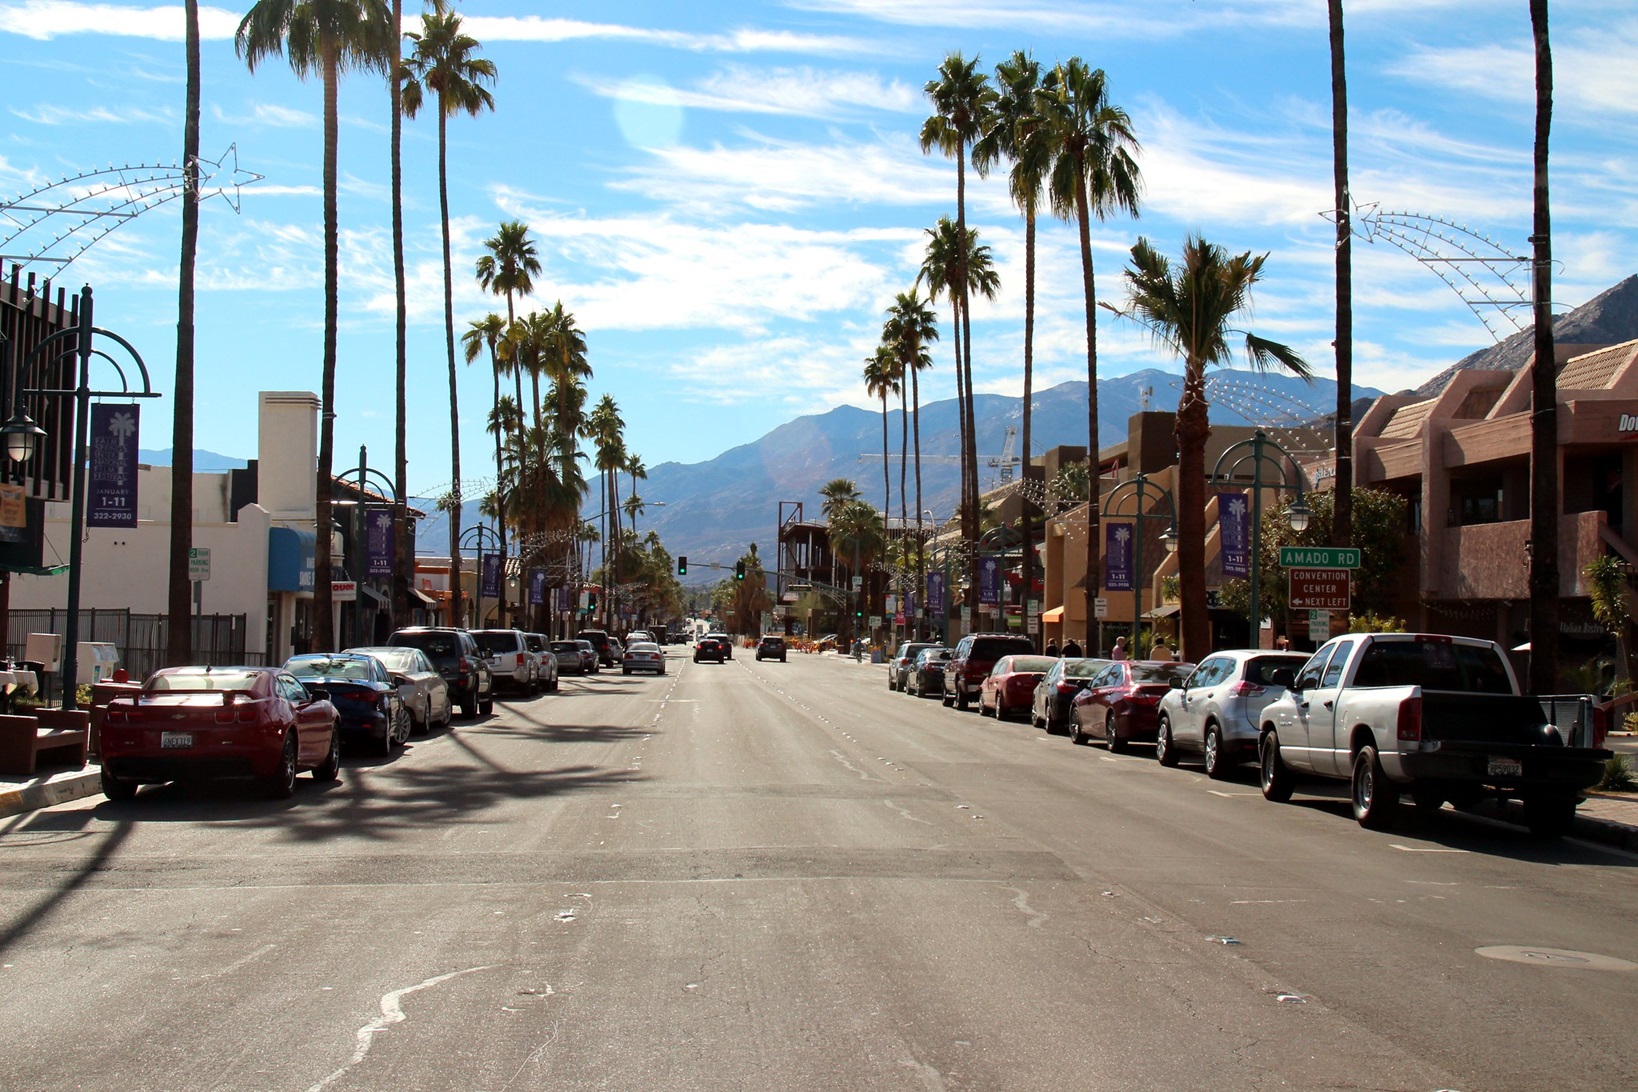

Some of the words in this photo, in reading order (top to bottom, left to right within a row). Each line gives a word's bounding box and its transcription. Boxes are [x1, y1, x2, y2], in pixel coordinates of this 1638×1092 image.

[101, 497, 126, 506] 1-11
[1228, 555, 1243, 563] 1-11
[1285, 552, 1329, 564] AMADO
[1338, 553, 1355, 565] RD
[1294, 571, 1347, 580] CONVENTION
[1303, 584, 1337, 593] CENTER
[1305, 598, 1325, 606] NEXT
[1328, 598, 1347, 606] LEFT
[1560, 621, 1583, 633] Italian
